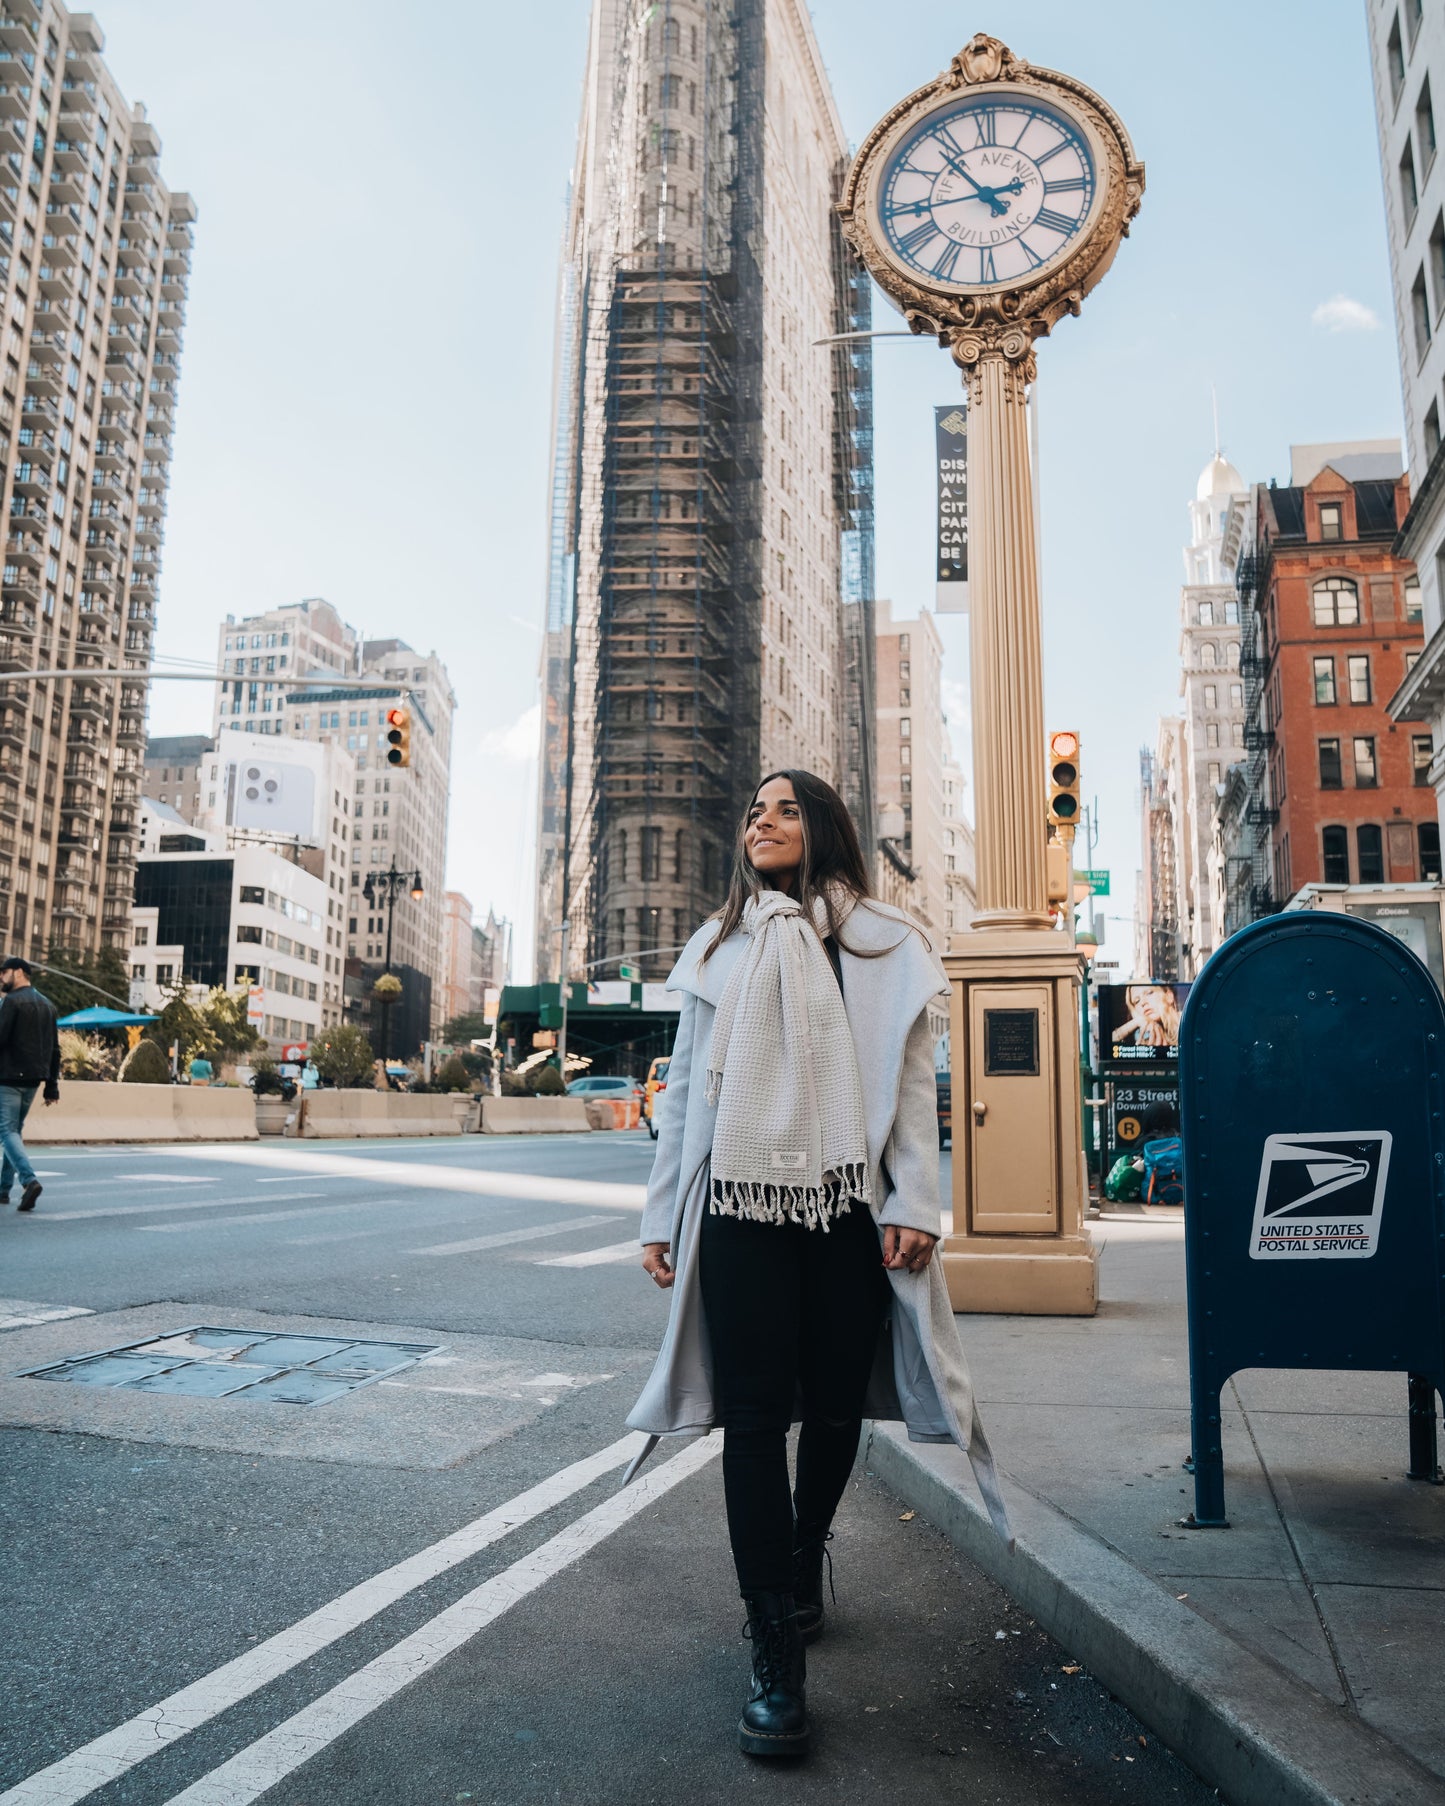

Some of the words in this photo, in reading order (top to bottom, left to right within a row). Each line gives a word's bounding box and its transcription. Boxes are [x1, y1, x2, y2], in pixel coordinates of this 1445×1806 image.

[973, 110, 997, 149] XII
[1034, 138, 1073, 167] II
[981, 152, 1038, 190] AVENUE
[940, 459, 968, 470] DIS
[940, 487, 952, 498] A
[940, 502, 967, 513] CIT
[940, 547, 960, 559] BE
[1116, 1089, 1134, 1101] 23
[1138, 1089, 1178, 1101] Street
[1123, 1122, 1135, 1136] R
[1260, 1225, 1313, 1237] UNITED
[1315, 1224, 1364, 1236] STATES
[1258, 1240, 1310, 1251] POSTAL
[1312, 1239, 1369, 1250] SERVICE
